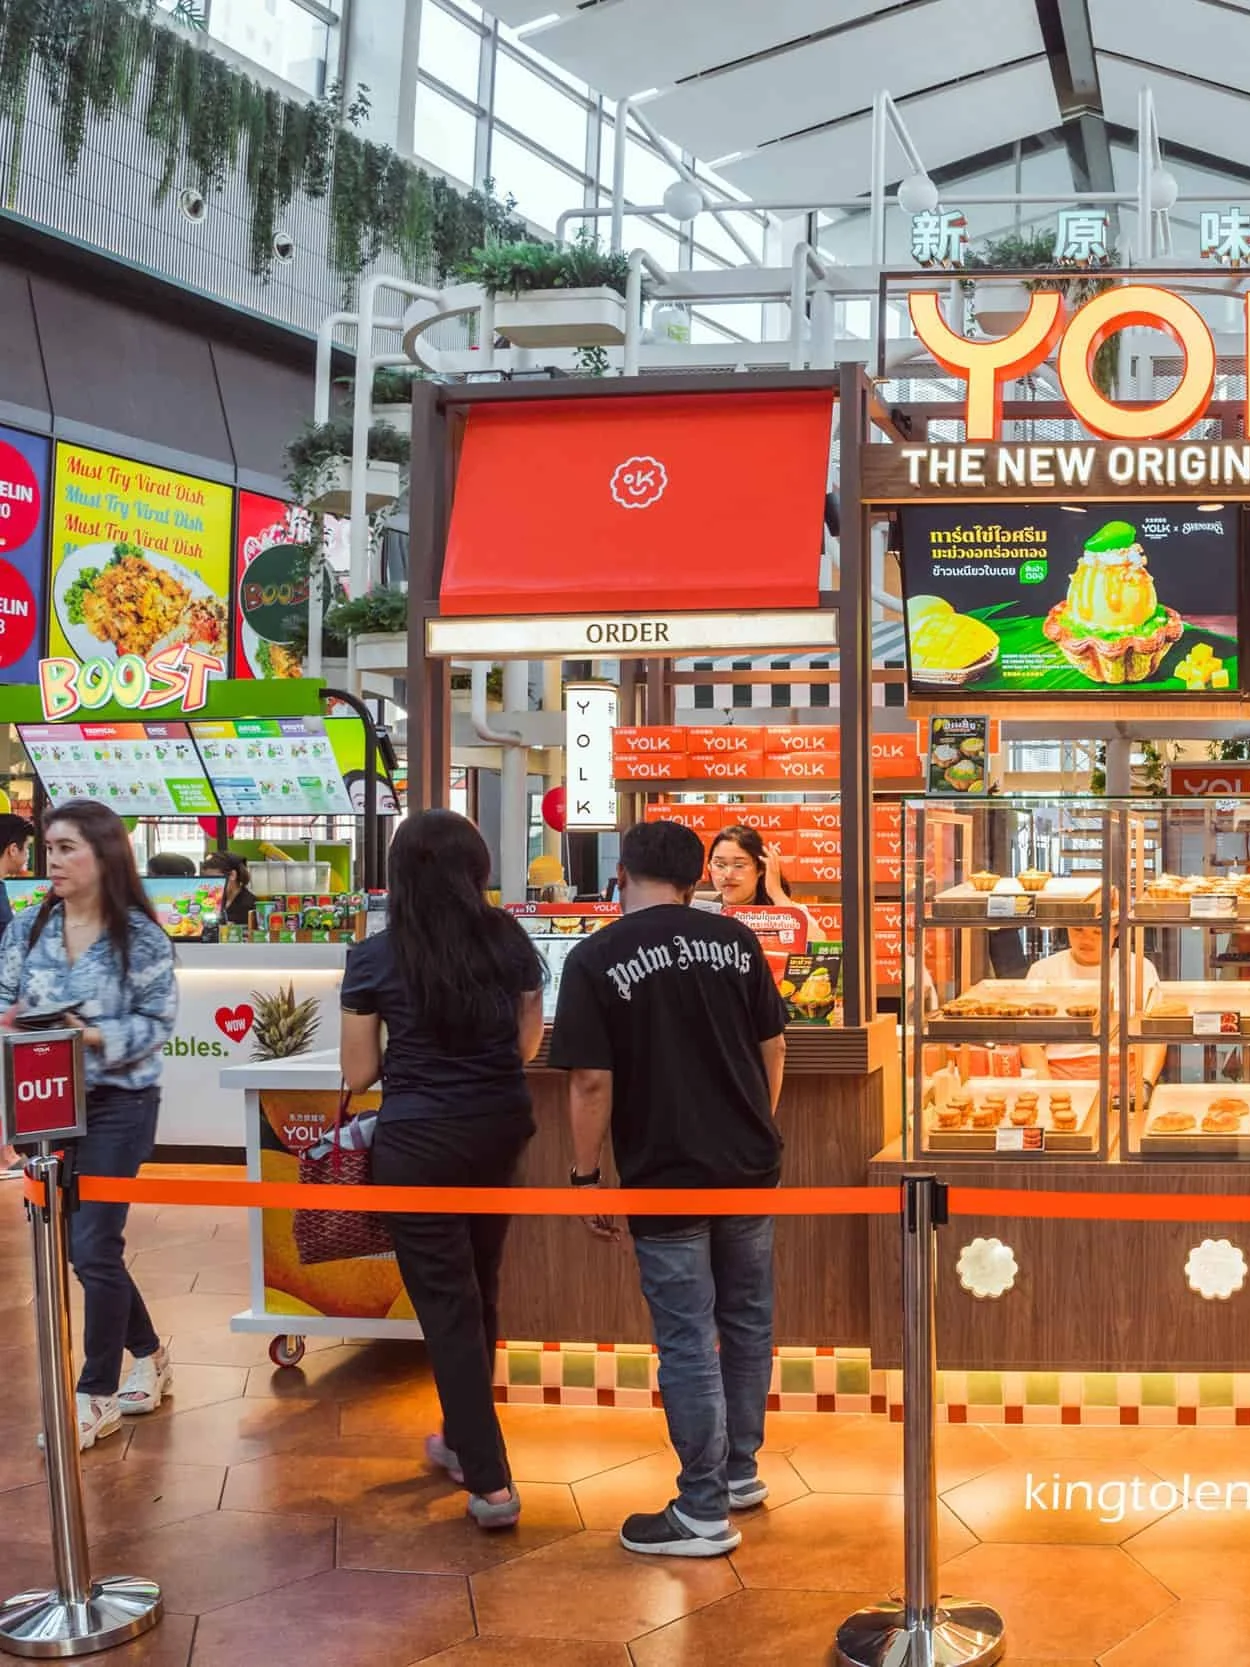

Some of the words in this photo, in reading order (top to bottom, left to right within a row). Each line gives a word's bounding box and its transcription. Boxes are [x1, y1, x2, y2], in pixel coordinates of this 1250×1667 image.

[902, 448, 982, 485] THE
[996, 448, 1096, 485] NEW
[66, 455, 103, 485] Must
[107, 466, 131, 493] Try
[135, 473, 171, 497] Viral
[175, 483, 205, 506] Dish
[0, 481, 33, 503] ELIN
[65, 484, 102, 509] Must
[105, 494, 130, 520] Try
[133, 501, 170, 525] Viral
[174, 509, 204, 532] Dish
[1141, 523, 1171, 533] YOLK
[64, 513, 101, 537] Must
[104, 522, 129, 543] Try
[133, 528, 168, 552] Viral
[173, 538, 203, 559] Dish
[586, 622, 669, 644] ORDER
[39, 643, 224, 720] BOOST
[627, 738, 671, 750] YOLK
[704, 737, 748, 750] YOLK
[780, 737, 825, 749] YOLK
[576, 700, 591, 815] YOLK
[871, 745, 904, 757] OLK
[627, 764, 671, 776] YOLK
[704, 763, 747, 776] YOLK
[780, 763, 825, 776] YOLK
[737, 815, 781, 827] YOLK
[813, 815, 841, 827] YOL
[813, 841, 841, 853] YOL
[813, 867, 841, 880] YOL
[593, 904, 618, 912] YOLK
[816, 916, 841, 928] YOL
[606, 945, 674, 1000] Palm
[673, 935, 752, 974] Angels
[224, 1018, 246, 1032] WOW
[163, 1037, 229, 1057] ables.
[17, 1077, 68, 1101] OUT
